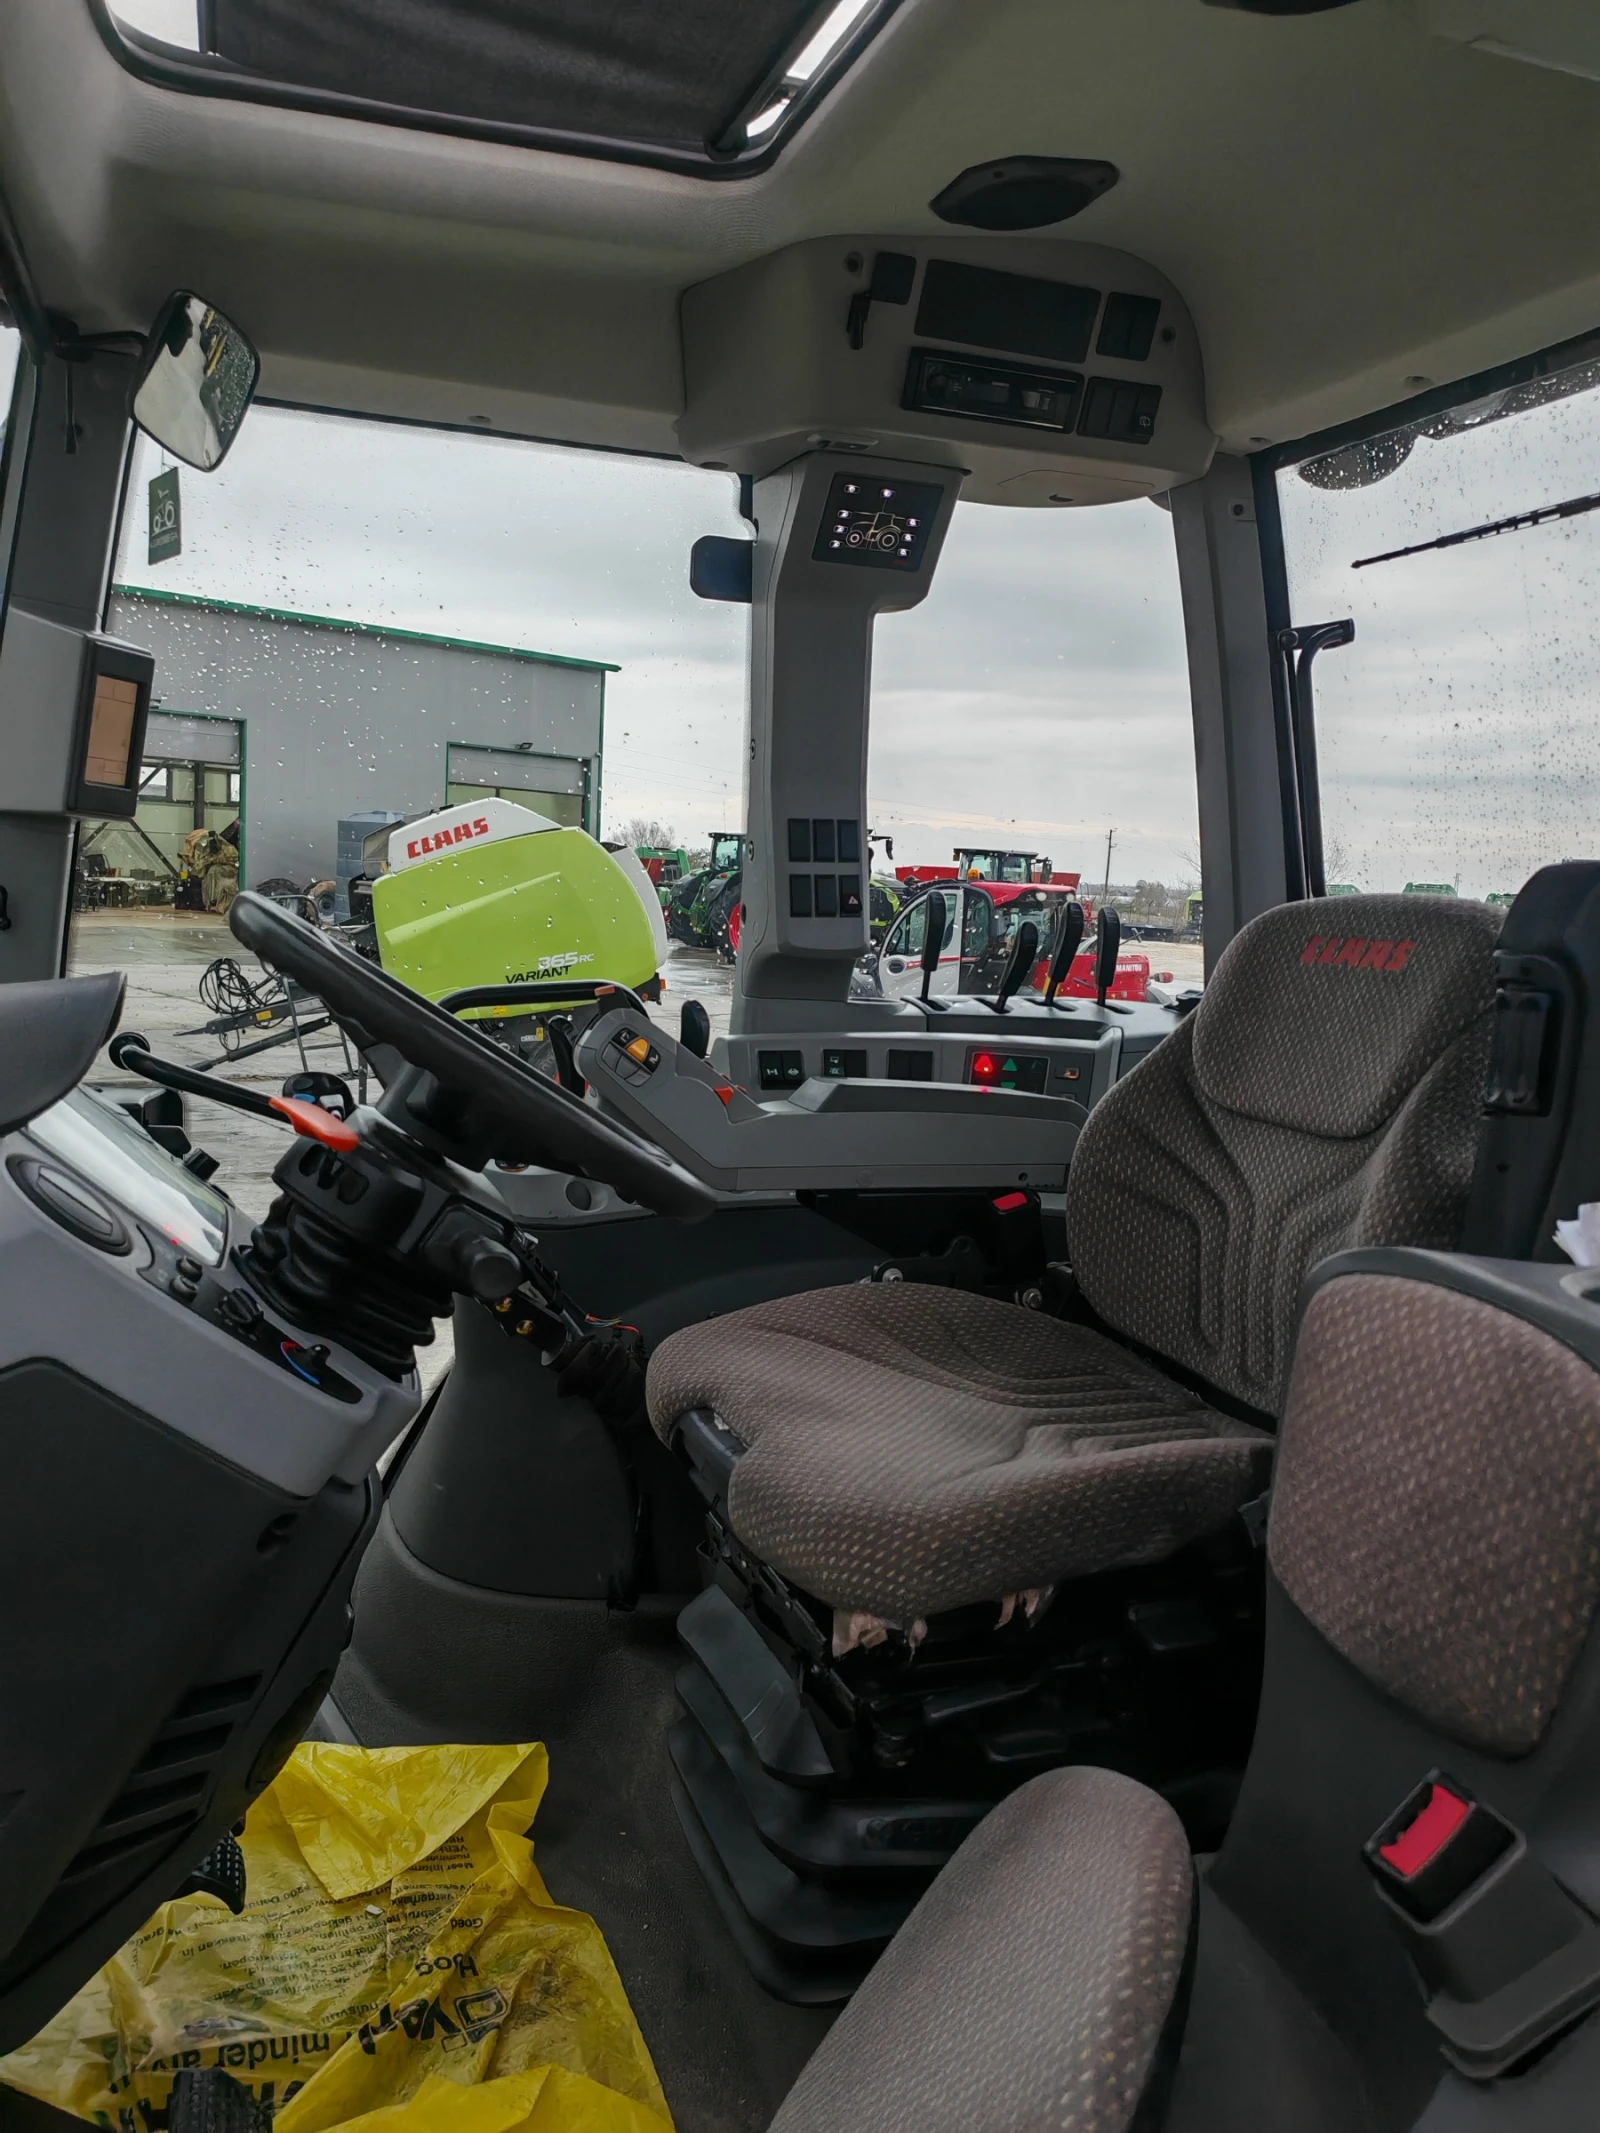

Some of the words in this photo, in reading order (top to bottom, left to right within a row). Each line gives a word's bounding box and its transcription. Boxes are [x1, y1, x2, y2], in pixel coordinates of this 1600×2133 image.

[406, 817, 489, 859] CLAAS
[538, 951, 579, 970] 365
[579, 953, 595, 964] RC
[1300, 936, 1416, 971] CLAAS
[505, 964, 572, 984] VARIANT
[1116, 963, 1143, 972] MANITOU
[216, 2033, 330, 2070] minder
